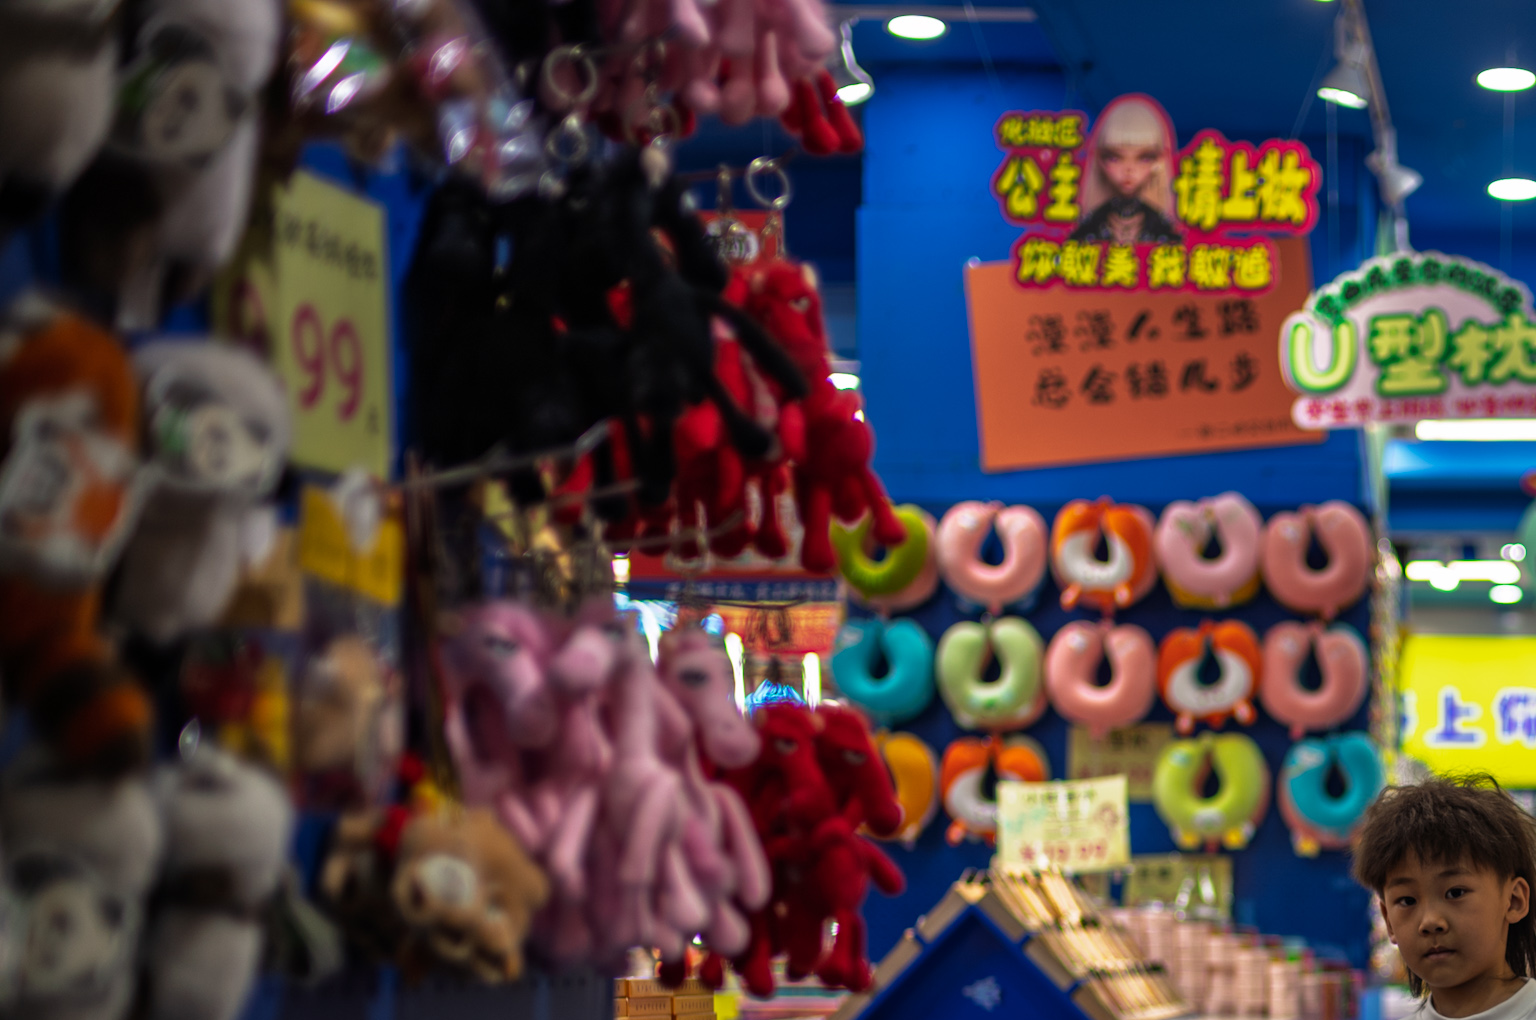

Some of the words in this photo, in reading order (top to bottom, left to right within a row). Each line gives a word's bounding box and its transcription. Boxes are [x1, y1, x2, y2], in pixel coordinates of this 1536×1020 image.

[996, 154, 1080, 220] 公主
[1025, 299, 1260, 356] 漫漫人生路
[1030, 351, 1259, 409] 总会错几步
